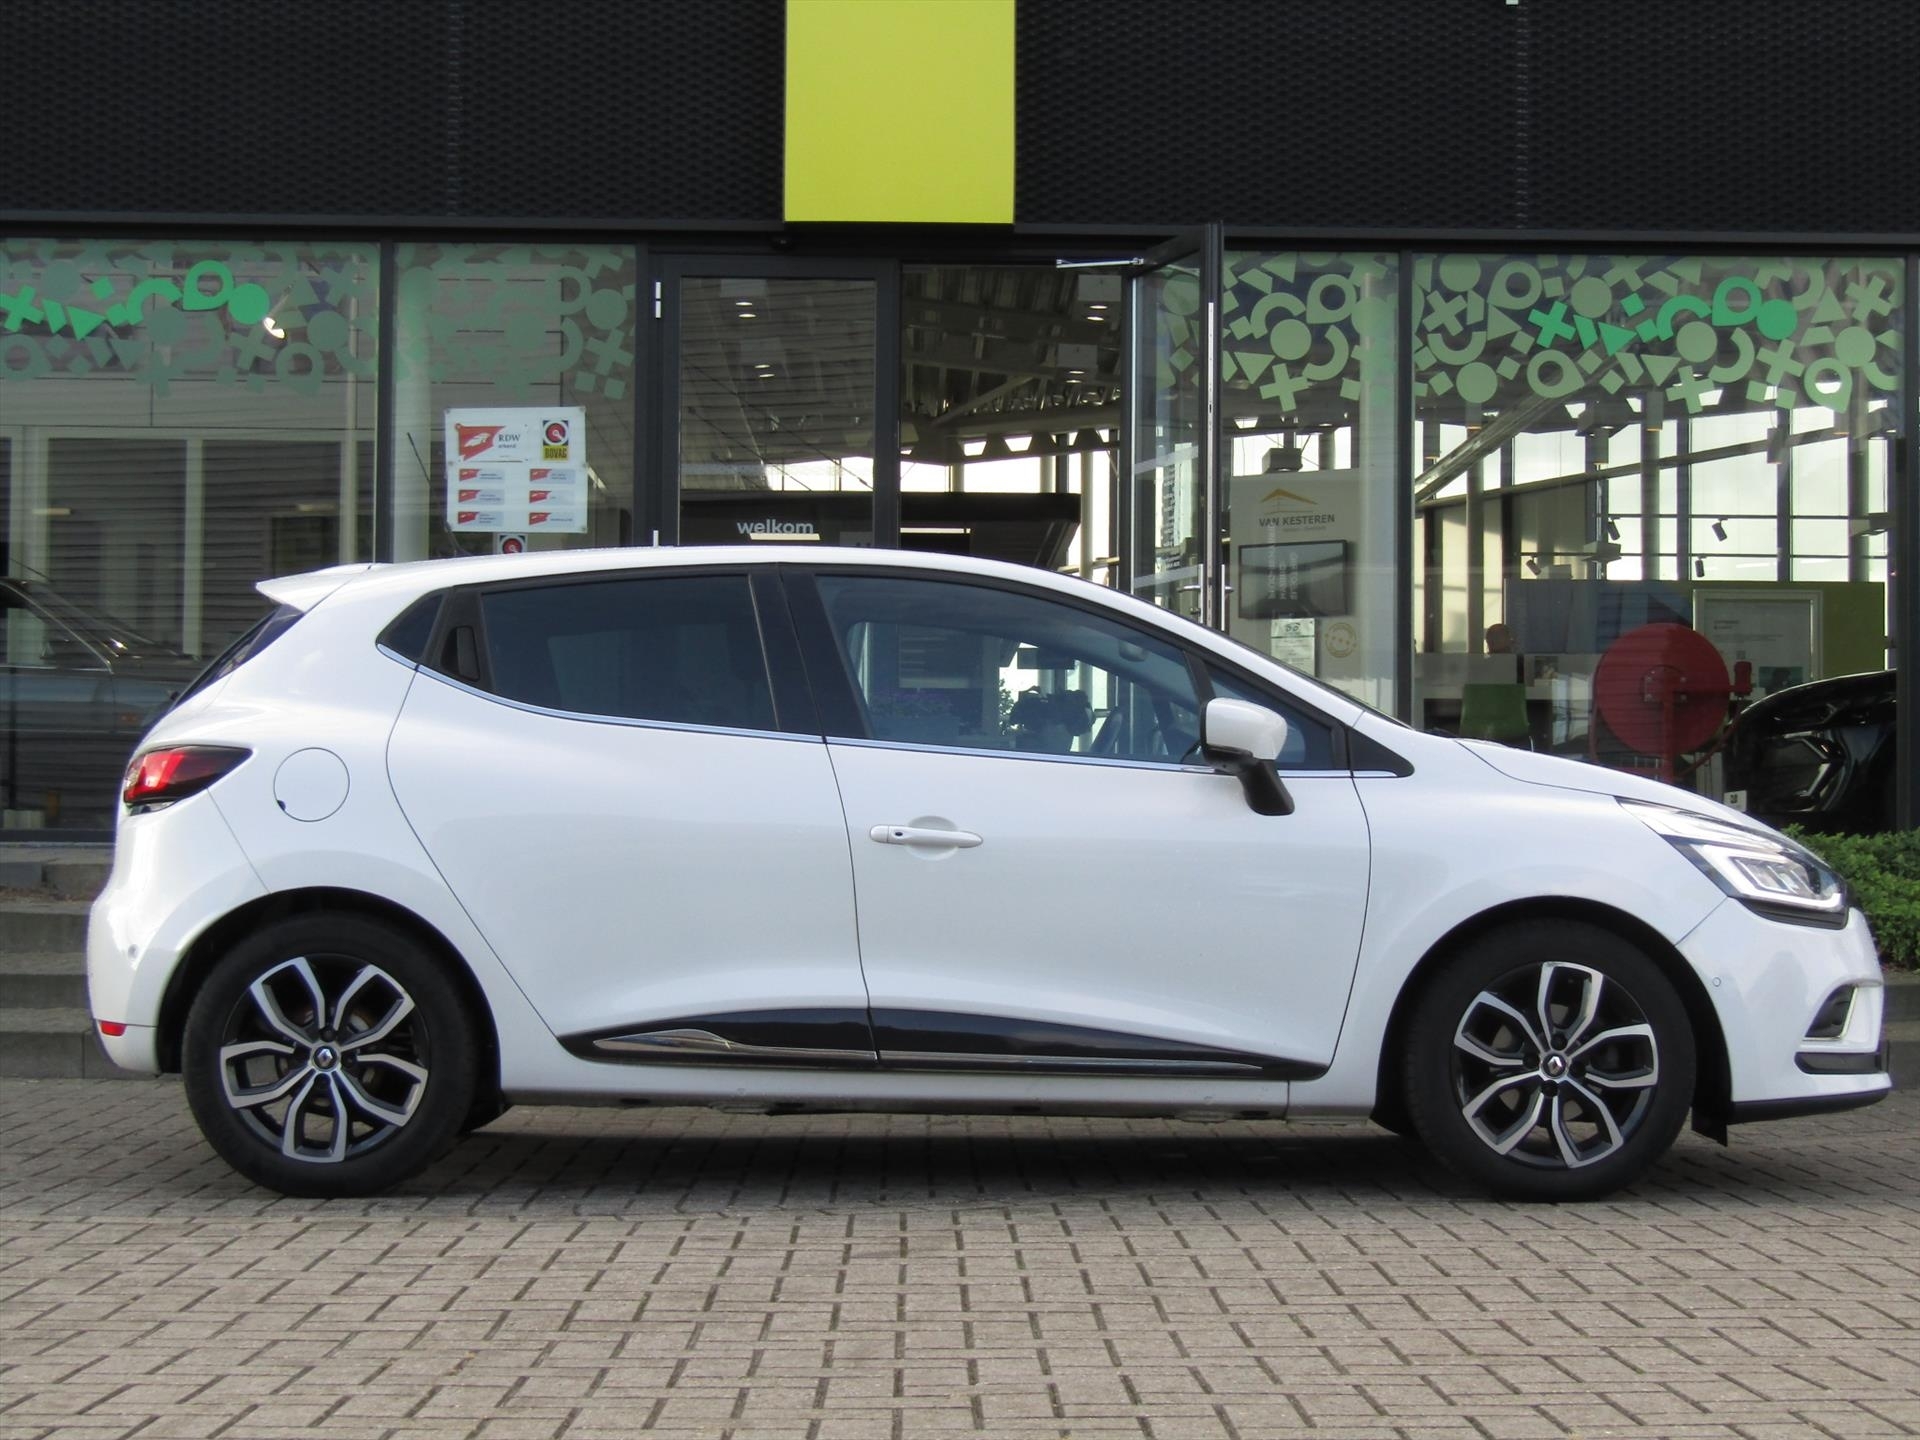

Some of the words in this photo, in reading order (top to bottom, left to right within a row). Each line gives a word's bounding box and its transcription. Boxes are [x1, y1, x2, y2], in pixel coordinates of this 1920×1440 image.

[498, 433, 521, 442] RDW
[545, 448, 568, 459] BOVAG
[736, 518, 814, 535] welkom
[1258, 517, 1280, 527] VAN
[1282, 514, 1336, 526] KESTEREN
